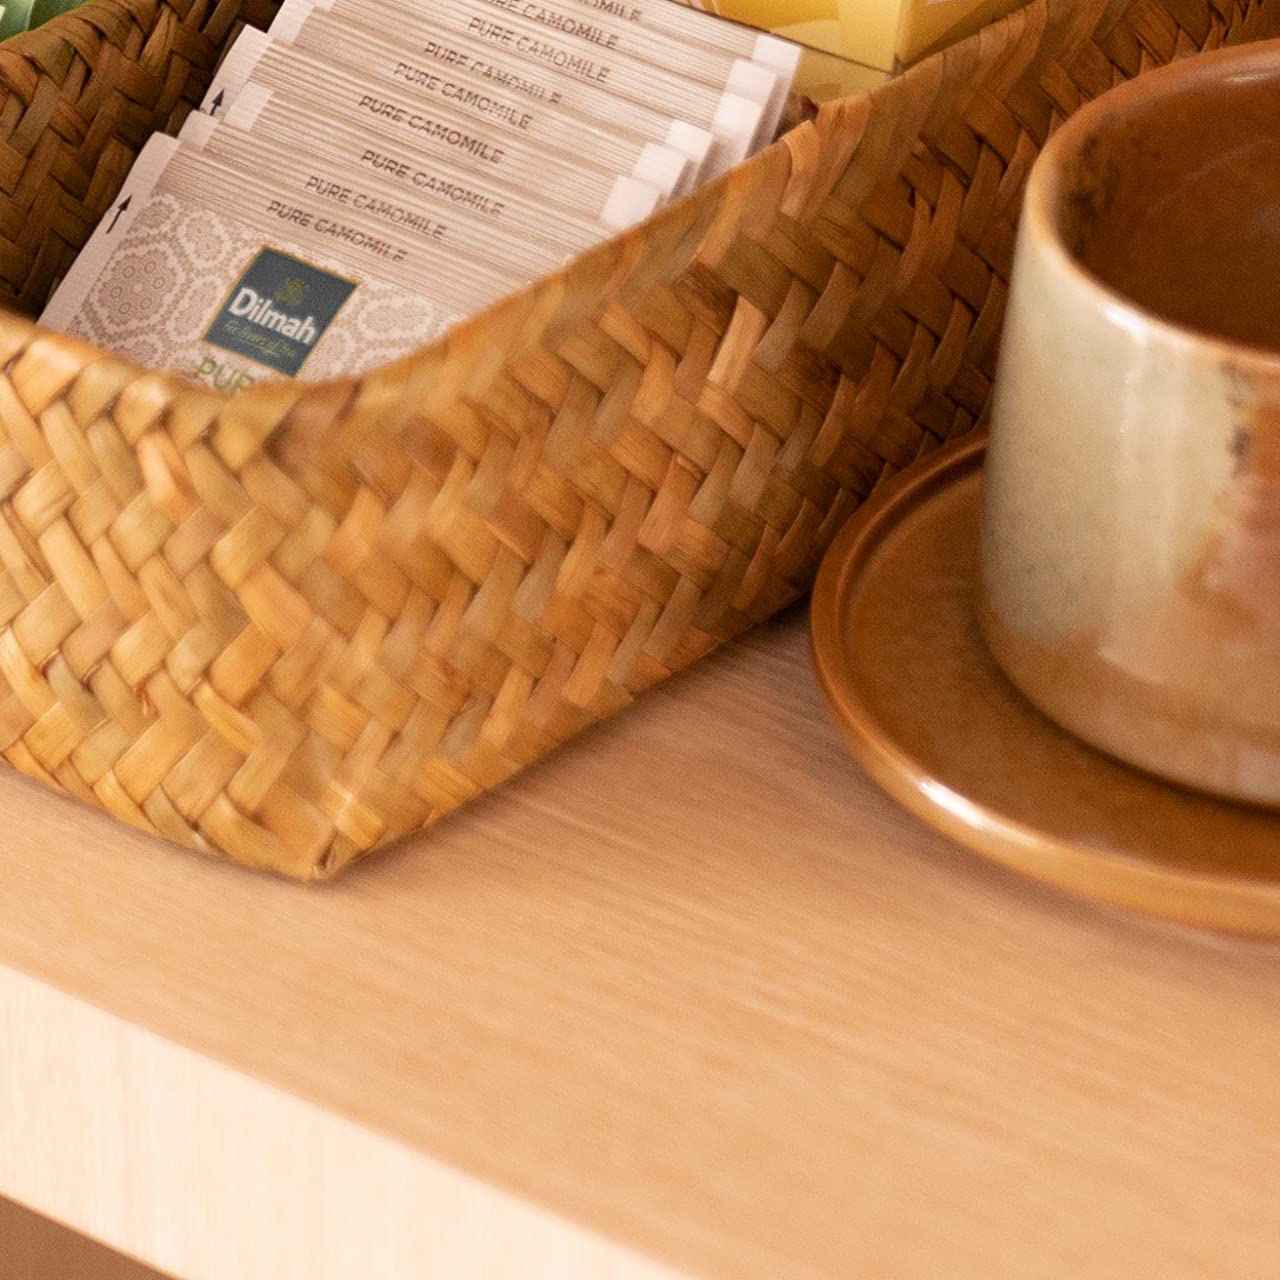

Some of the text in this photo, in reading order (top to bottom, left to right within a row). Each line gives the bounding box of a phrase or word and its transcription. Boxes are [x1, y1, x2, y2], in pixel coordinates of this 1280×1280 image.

[468, 16, 611, 84] PURE CAMOMILE
[522, 3, 620, 51] CAMOMILE
[393, 61, 533, 131] PURE CAMOMILE
[424, 41, 563, 106] PURE CAMOMILE
[358, 94, 505, 165] PURE CAMOMILE
[305, 175, 448, 241] PURE CAMOMILE
[361, 149, 505, 217] PURE CAMOMILE
[266, 200, 409, 263] PURE CAMOMILE
[227, 286, 317, 345] Dilmah
[193, 356, 256, 394] PUR
